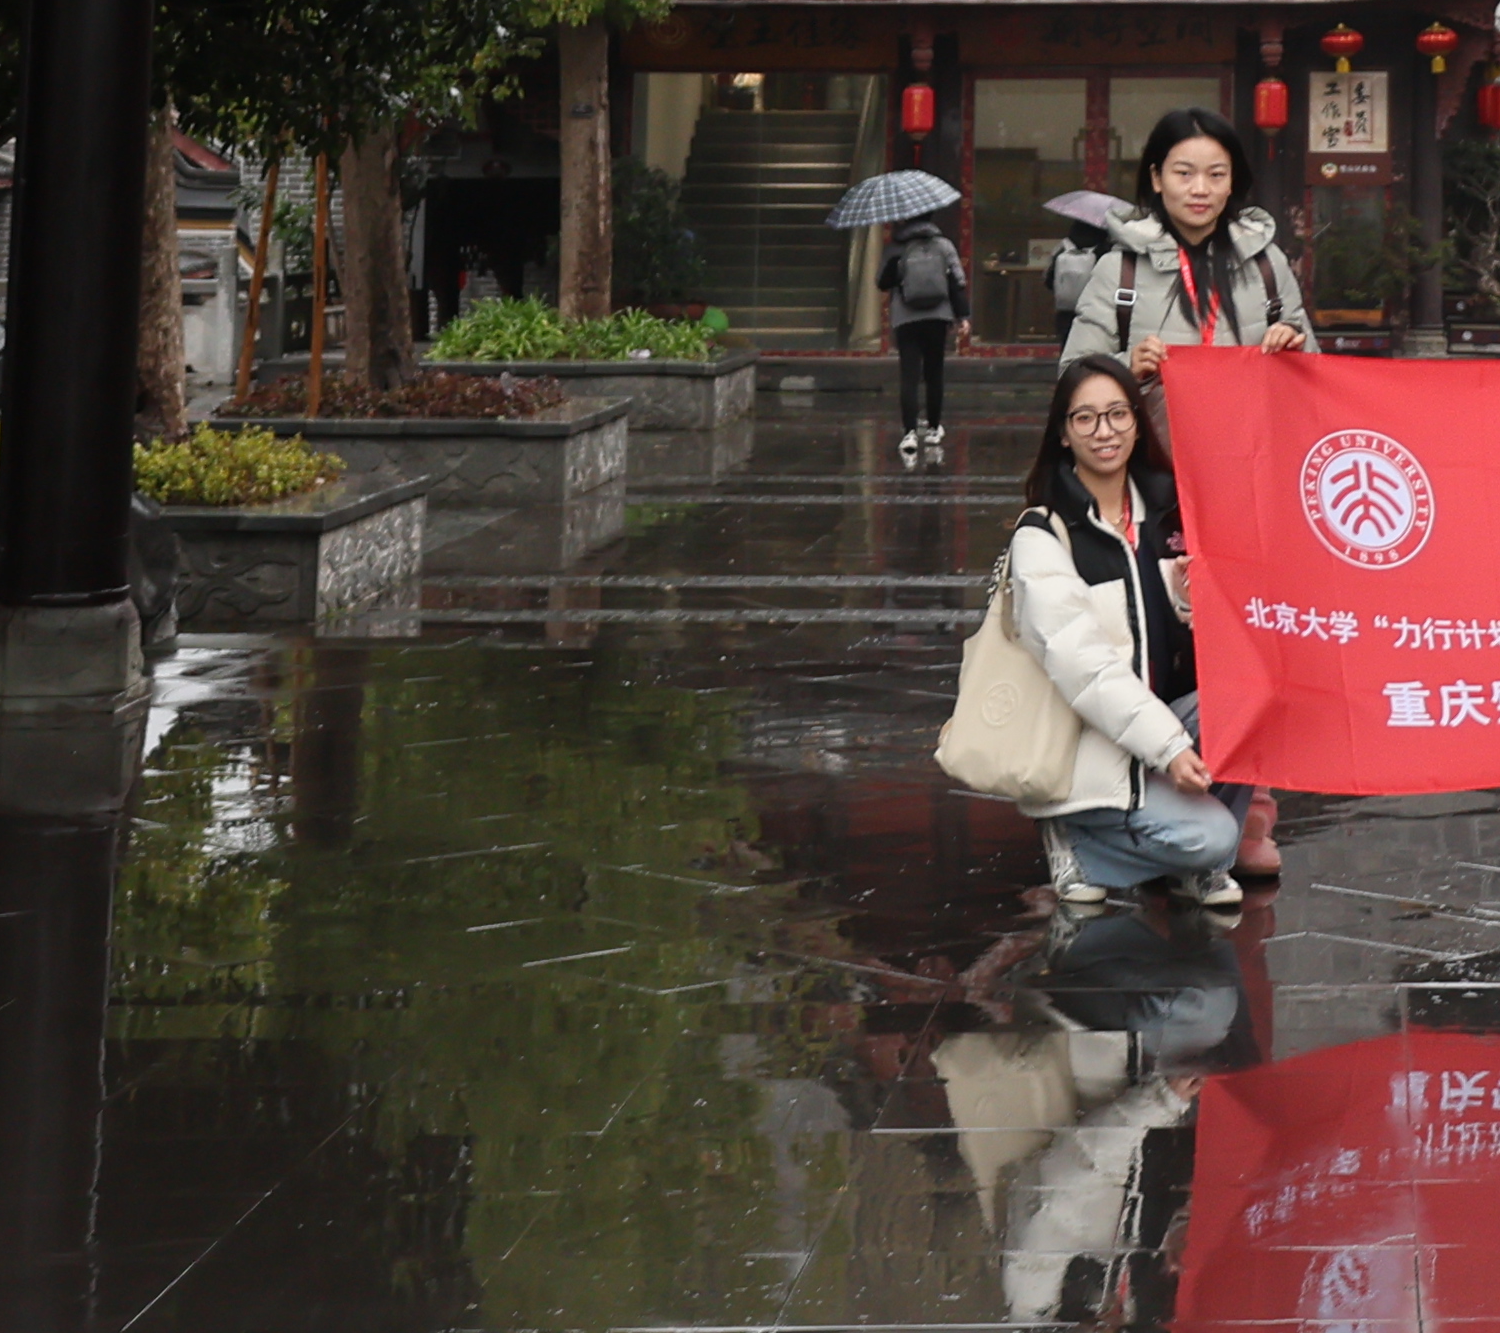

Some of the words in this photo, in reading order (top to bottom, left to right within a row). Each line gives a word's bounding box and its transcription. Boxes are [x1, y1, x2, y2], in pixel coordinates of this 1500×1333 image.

[1321, 81, 1342, 149] 工作室
[1305, 442, 1334, 522] PEKING
[1339, 434, 1430, 533] UNIVERSITY
[1344, 545, 1400, 565] 1898
[1245, 596, 1360, 645] 北京大学
